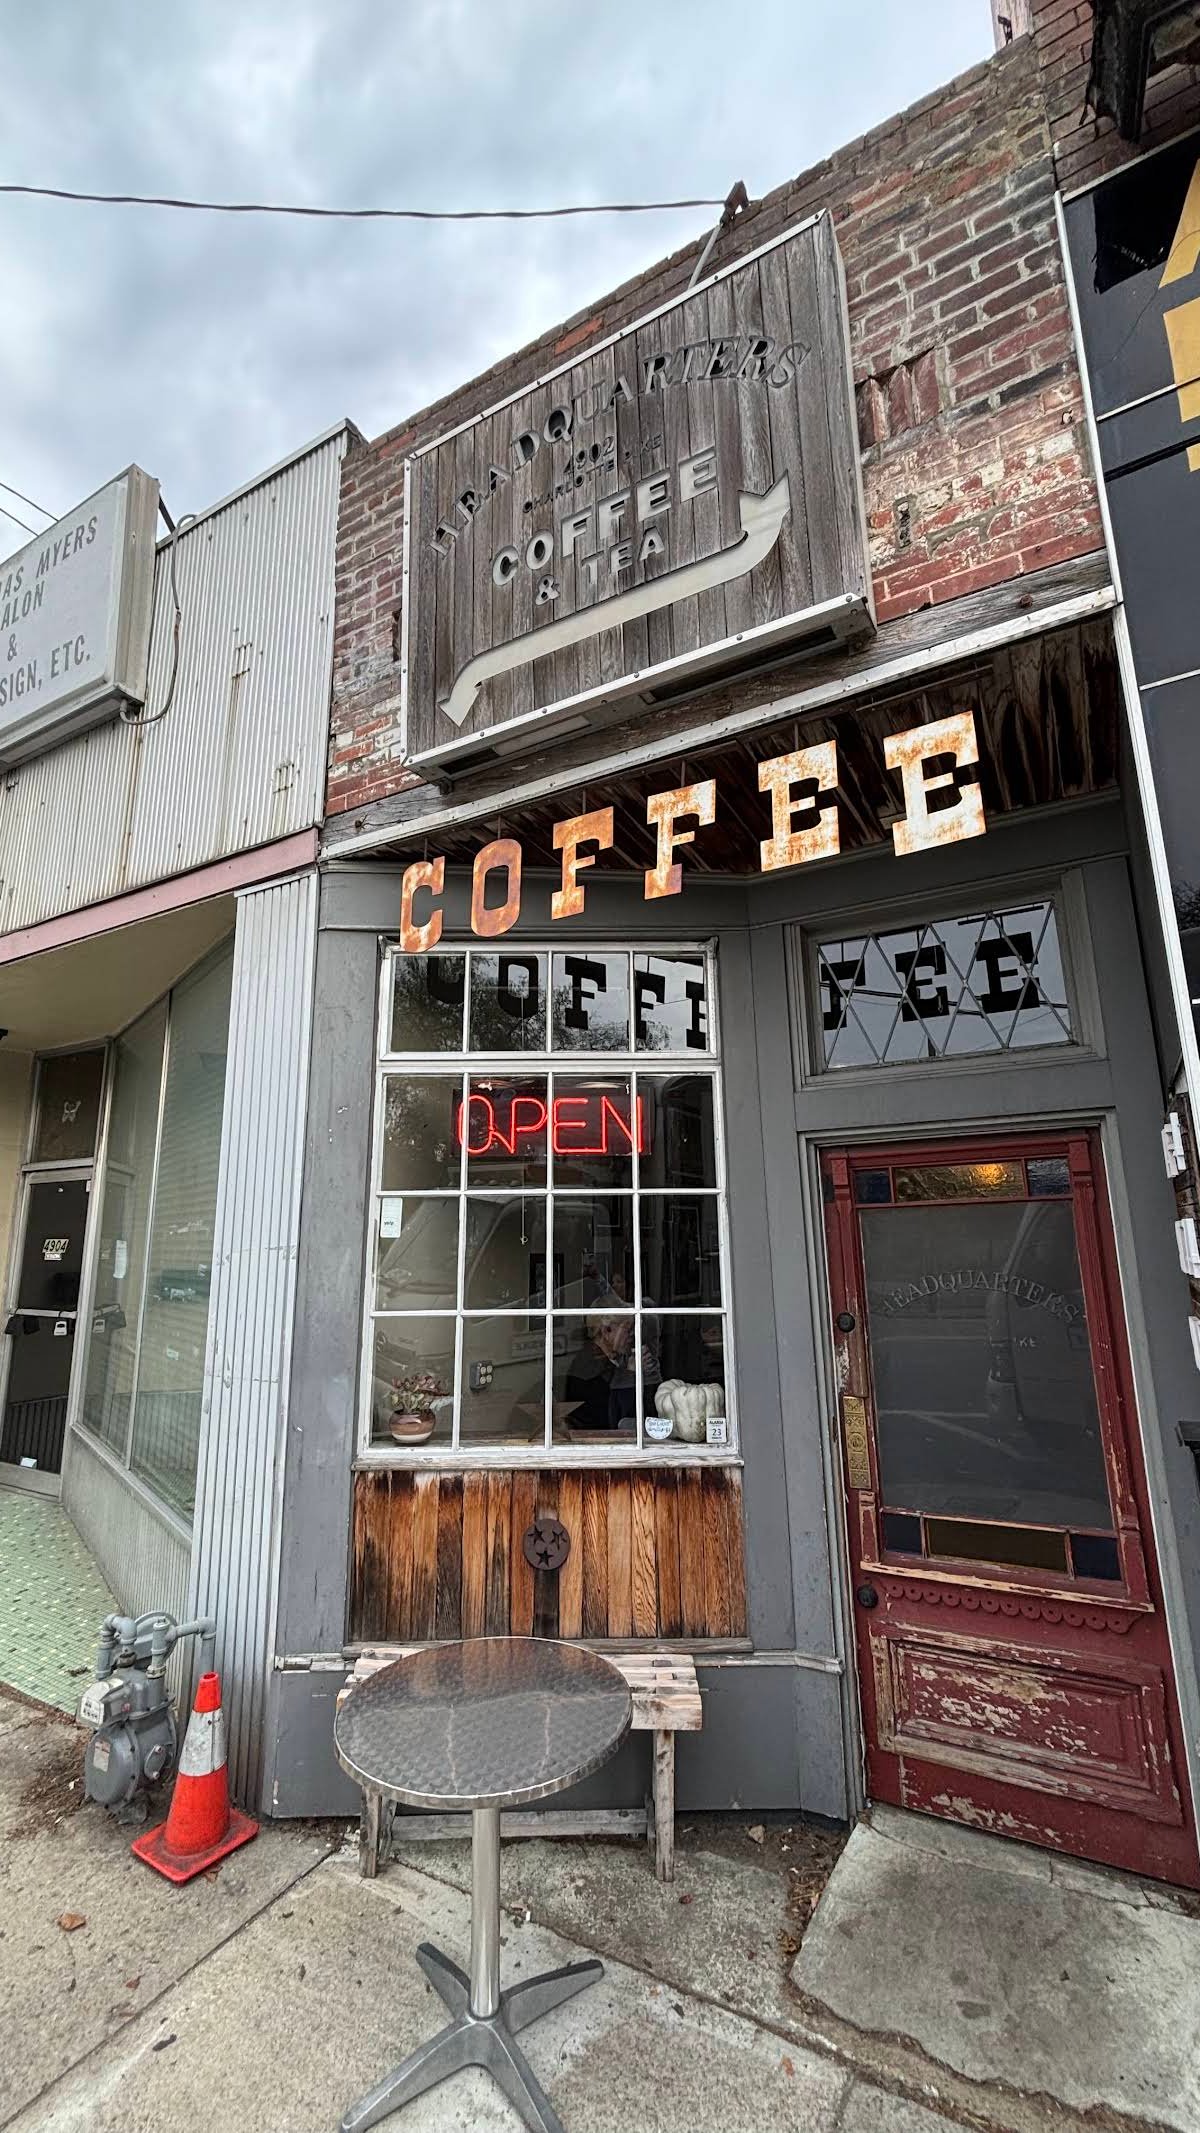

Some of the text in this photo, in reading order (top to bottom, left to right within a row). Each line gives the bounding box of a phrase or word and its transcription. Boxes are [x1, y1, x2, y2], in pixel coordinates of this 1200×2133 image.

[427, 335, 812, 558] HEADQUARTERS
[563, 436, 615, 474] 4902
[492, 446, 717, 586] COFFEE
[0, 516, 98, 600] AS MYERS
[535, 528, 665, 606] & TEA
[7, 633, 18, 662] &
[50, 634, 91, 679] ETC.
[400, 710, 987, 953] COFFEE
[457, 1095, 644, 1154] OPEN
[43, 1239, 68, 1252] 4904
